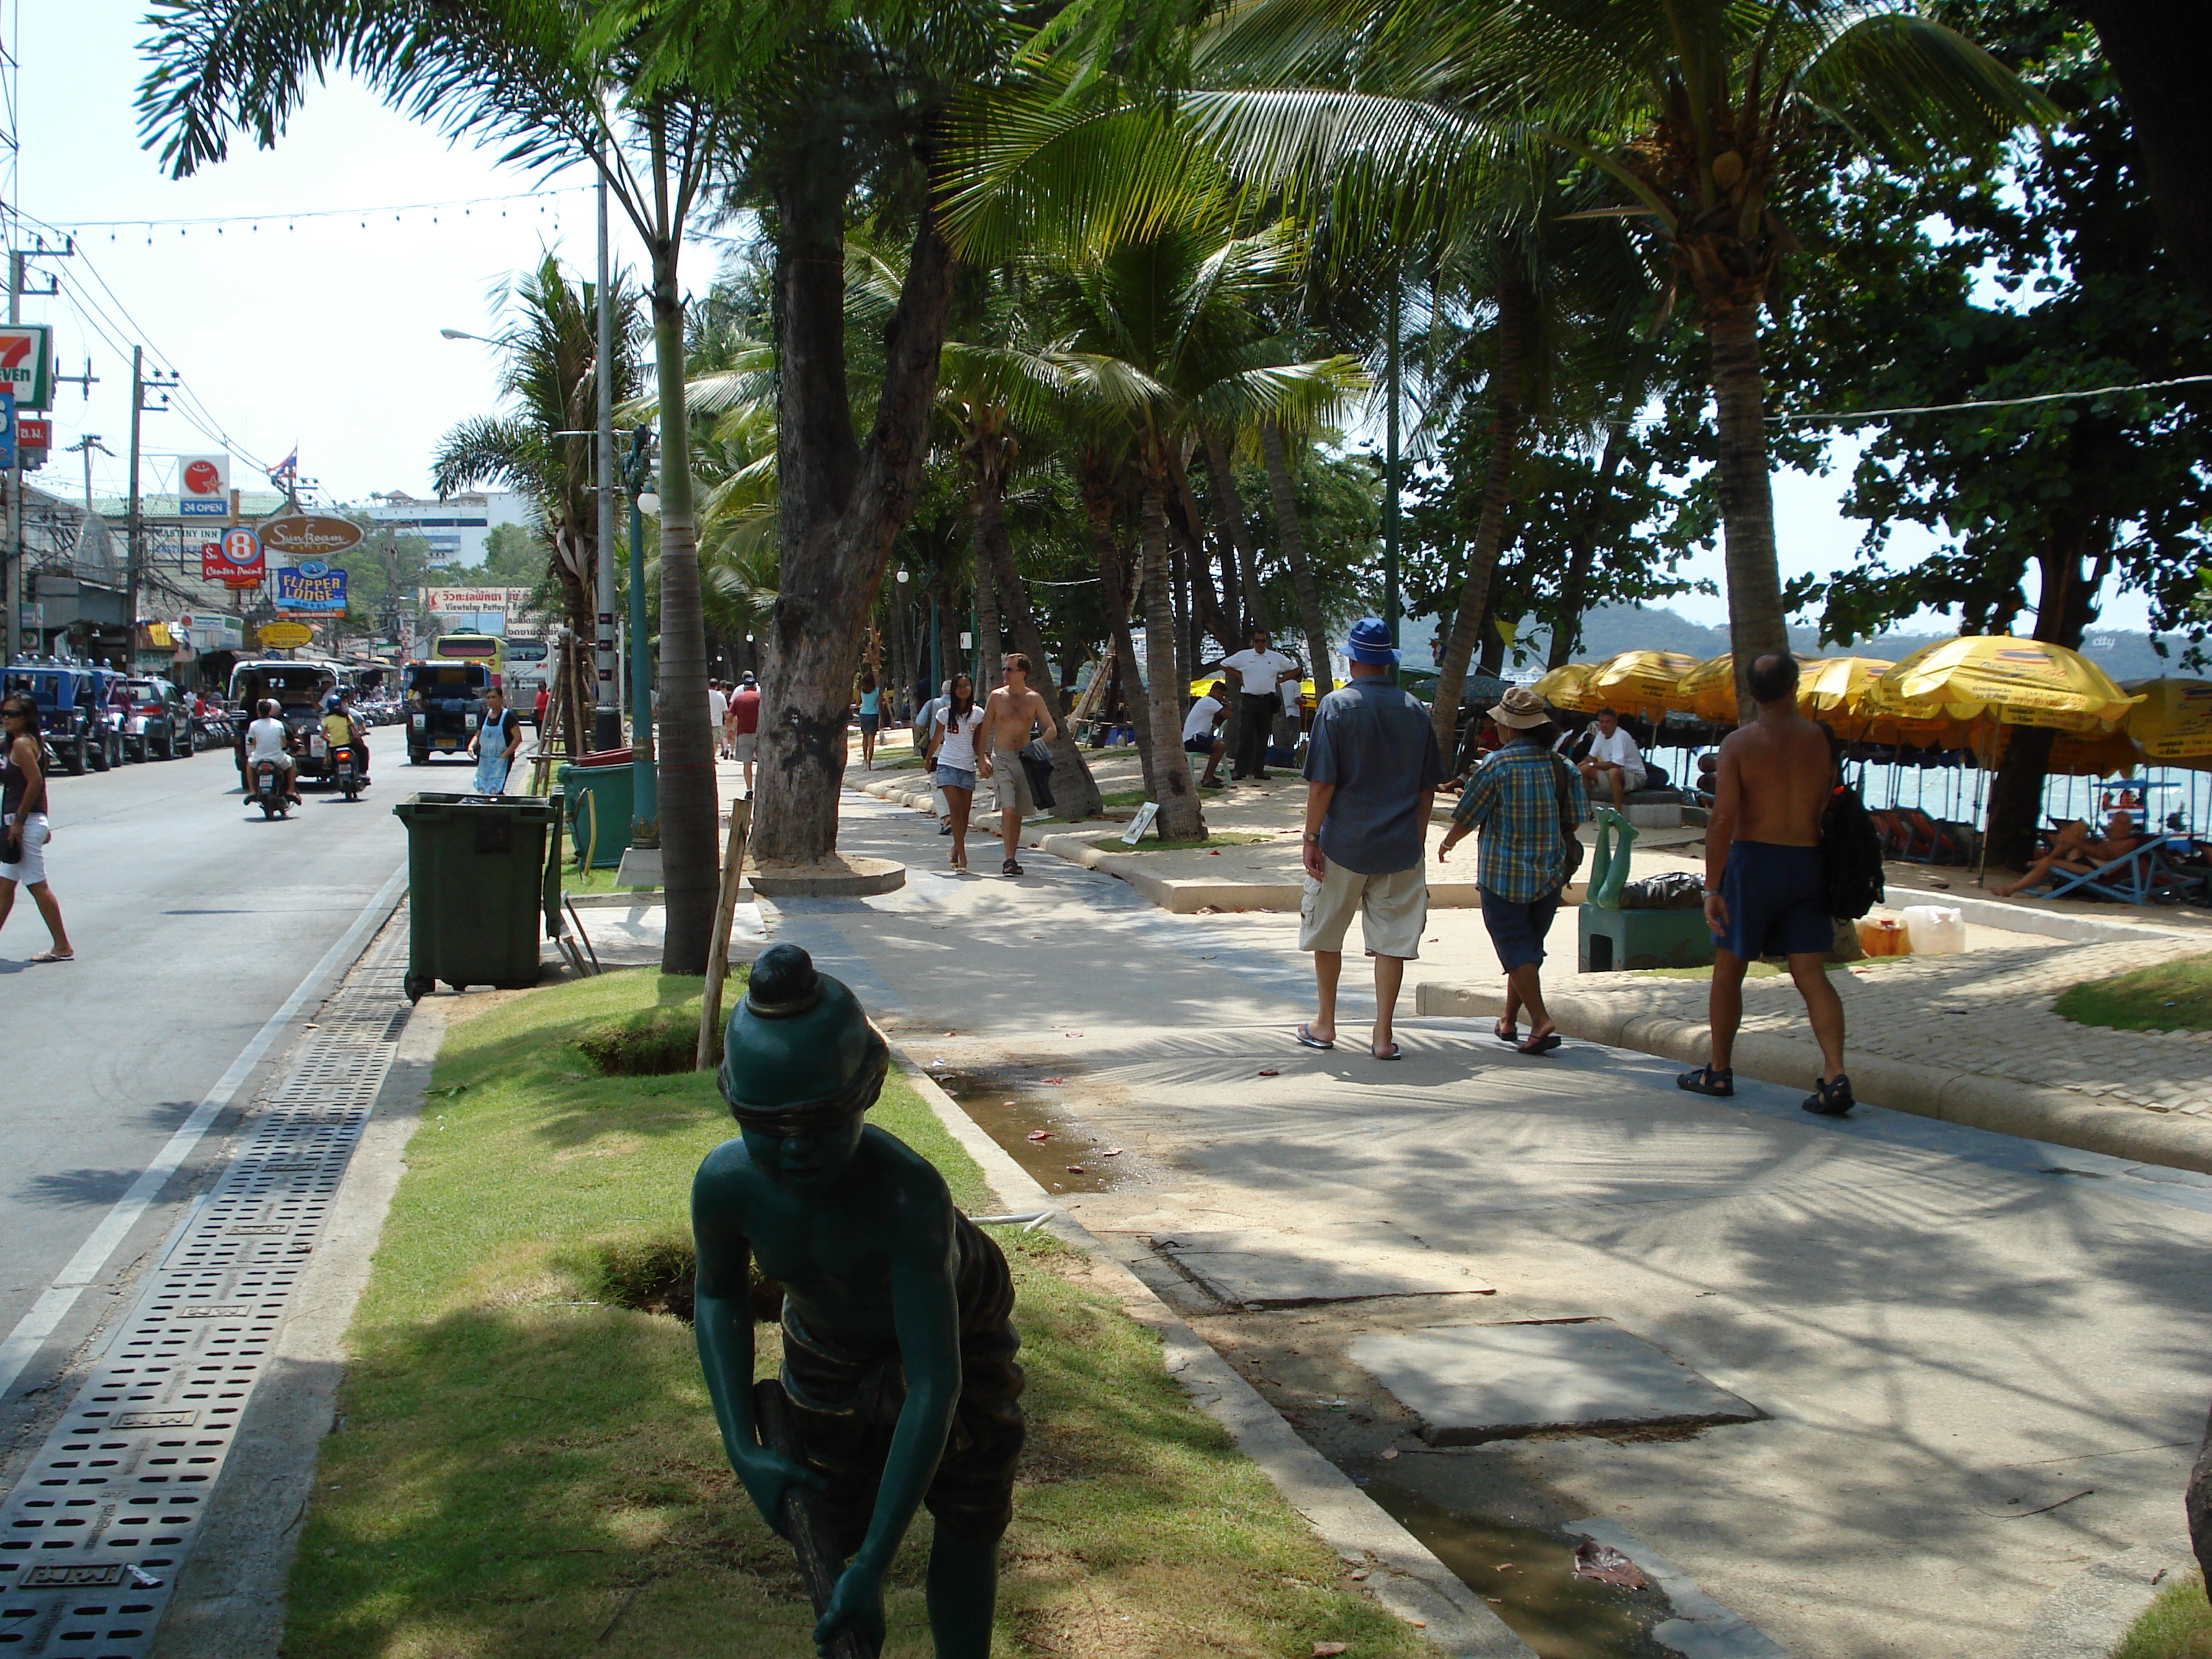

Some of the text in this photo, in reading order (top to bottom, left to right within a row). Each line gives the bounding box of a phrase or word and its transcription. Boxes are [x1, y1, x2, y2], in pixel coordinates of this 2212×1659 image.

[0, 336, 30, 368] 7
[230, 534, 250, 558] 8
[206, 566, 263, 576] Center Point
[283, 575, 341, 590] FLIPPER
[285, 587, 333, 601] LODGE
[2092, 636, 2116, 649] city
